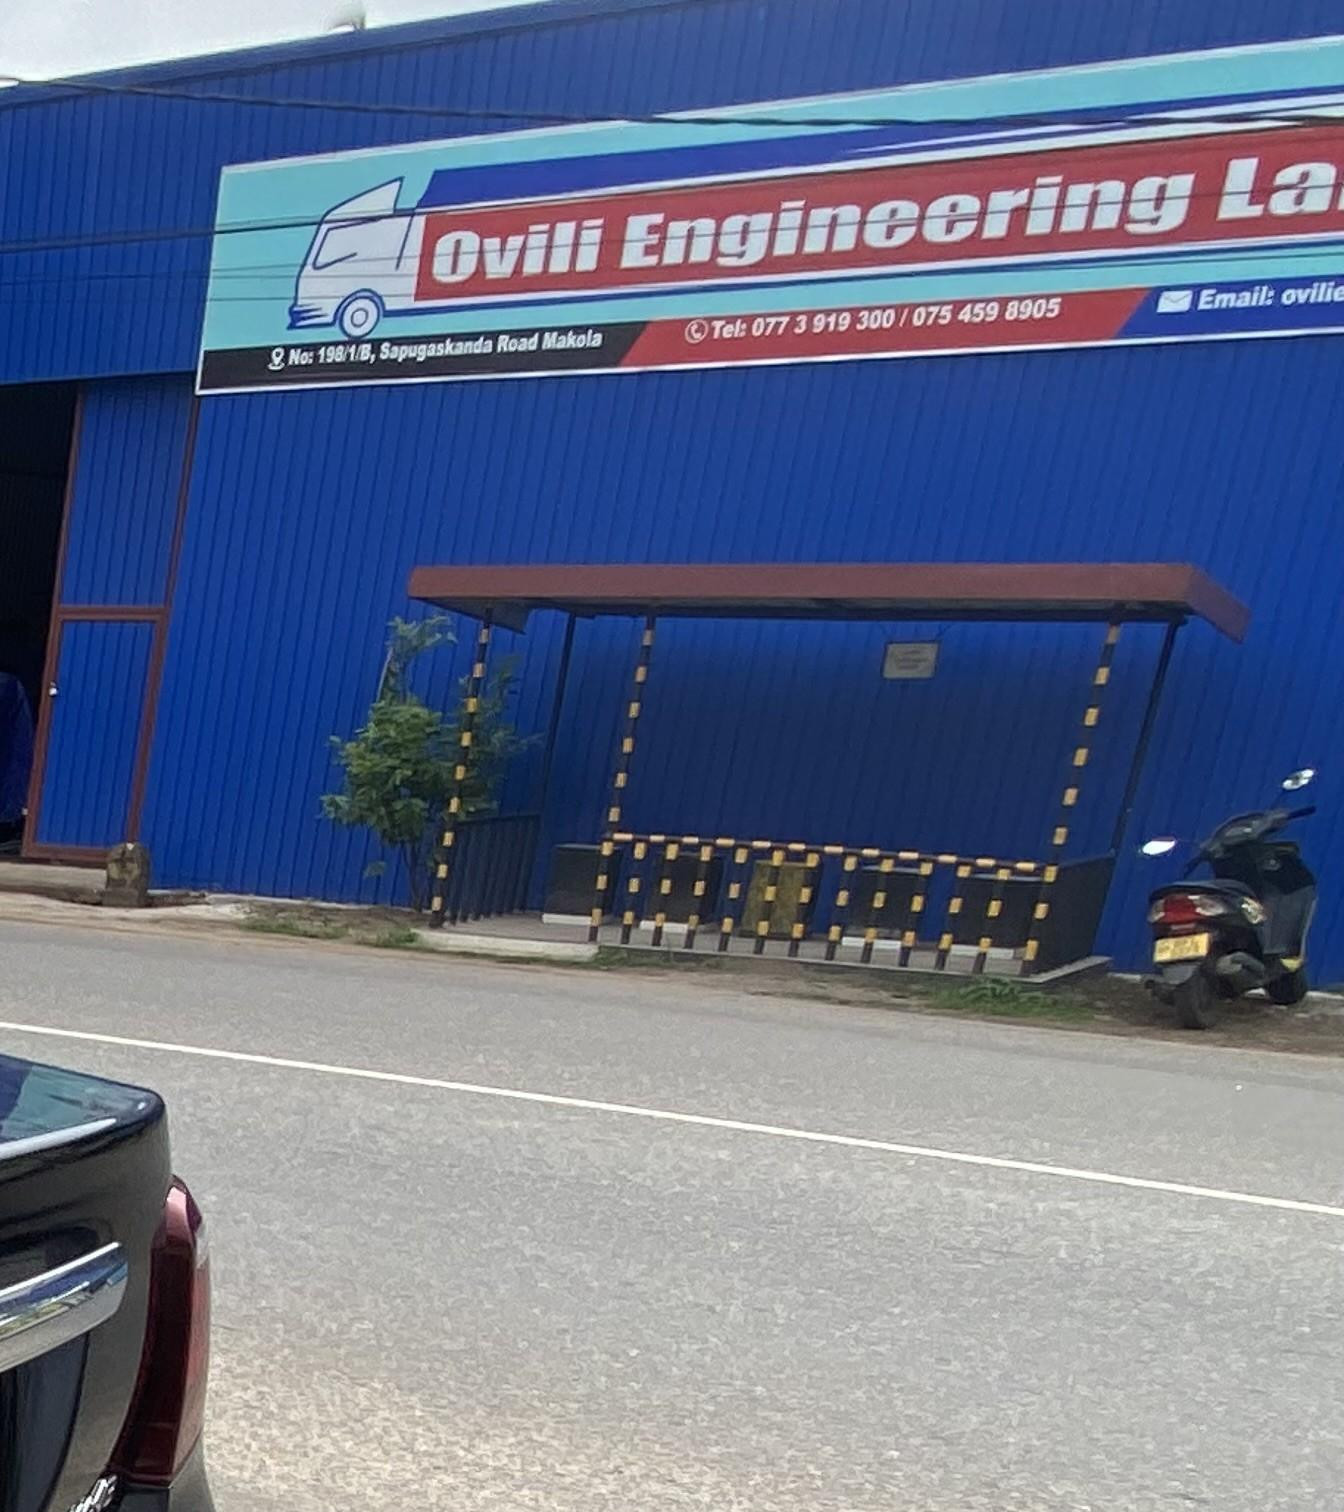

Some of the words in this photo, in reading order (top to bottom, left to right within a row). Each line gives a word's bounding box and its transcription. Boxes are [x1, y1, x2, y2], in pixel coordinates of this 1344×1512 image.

[430, 218, 601, 284] Ovili
[618, 172, 1197, 271] Engineering
[1216, 157, 1344, 221] La
[1198, 286, 1275, 310] Email:
[712, 319, 746, 340] Tel:
[752, 315, 791, 336] 077
[794, 314, 807, 334] 3
[813, 311, 852, 332] 919
[857, 308, 896, 330] 300
[899, 306, 909, 328] /
[912, 304, 951, 327] 075
[958, 301, 999, 323] 459
[1005, 297, 1062, 320] 8905
[289, 349, 314, 366] No:
[380, 336, 493, 363] Sapugaskanda
[498, 334, 538, 352] Road
[542, 329, 604, 350] Makola
